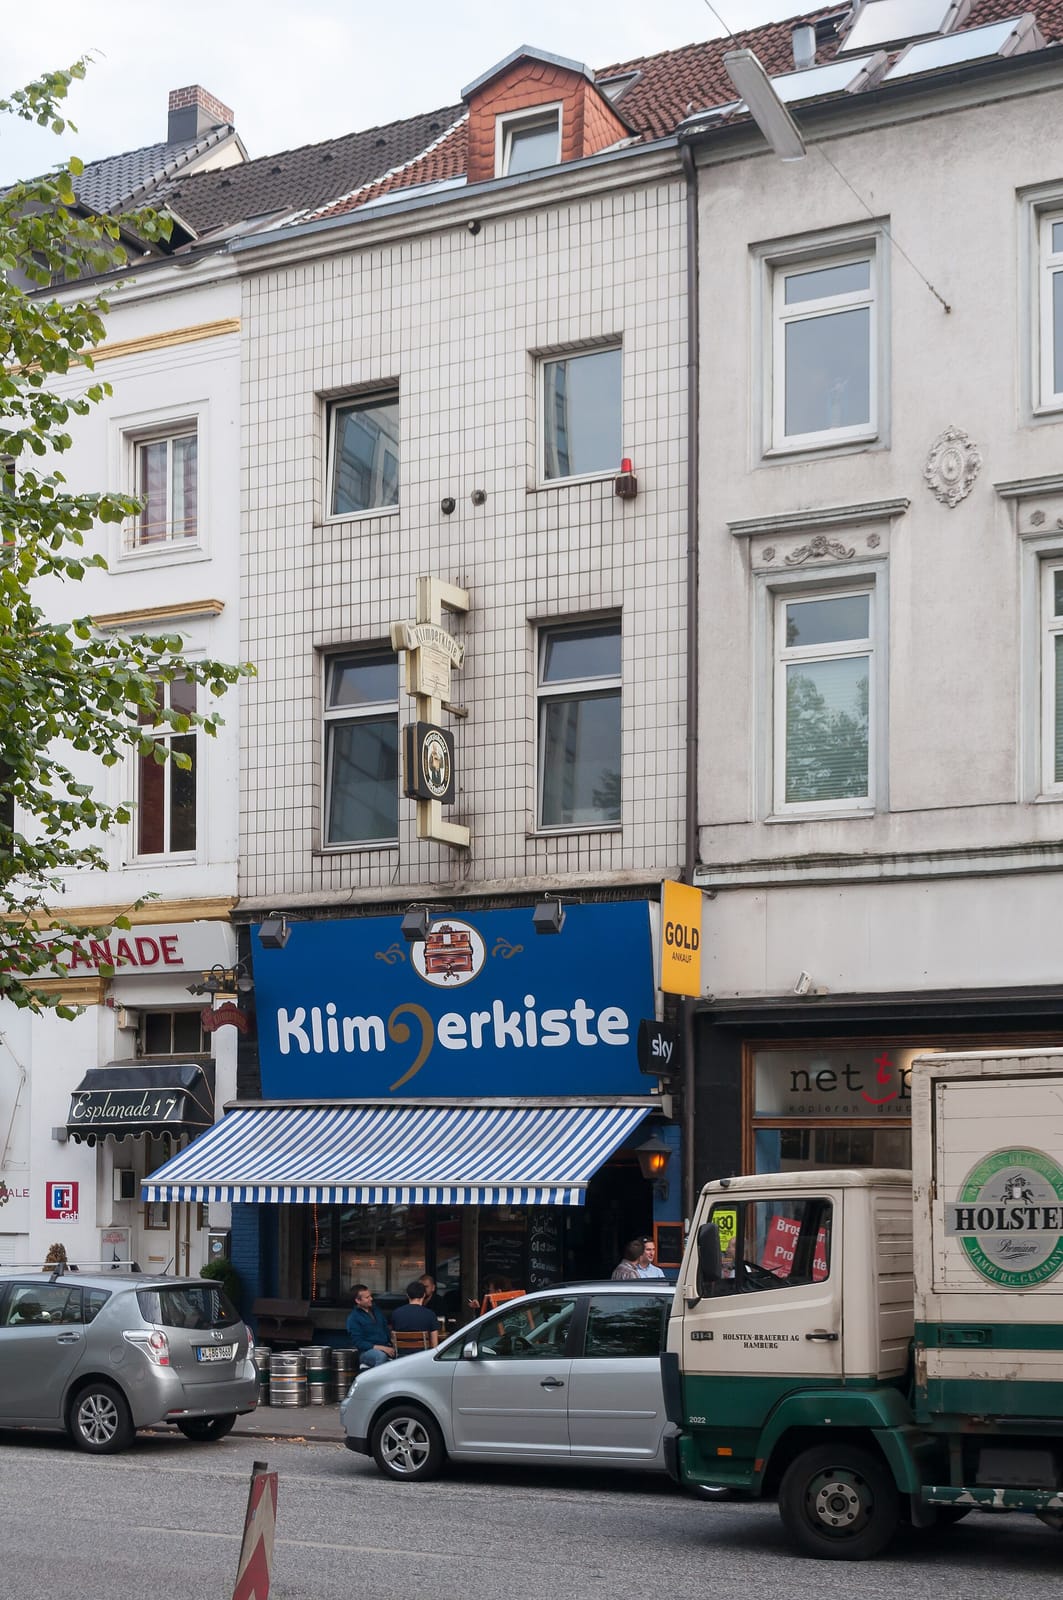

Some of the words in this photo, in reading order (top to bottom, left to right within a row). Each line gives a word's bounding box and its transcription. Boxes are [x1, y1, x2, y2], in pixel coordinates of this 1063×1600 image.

[665, 921, 700, 951] GOLD
[672, 951, 692, 964] ANKAUF
[652, 1033, 673, 1064] sky
[72, 1091, 151, 1123] Esplanade
[152, 1098, 177, 1120] 17
[60, 1211, 79, 1220] Cash
[955, 1207, 1063, 1231] HOLSTE
[722, 1333, 789, 1341] HOLSTEN-BRAUEREI
